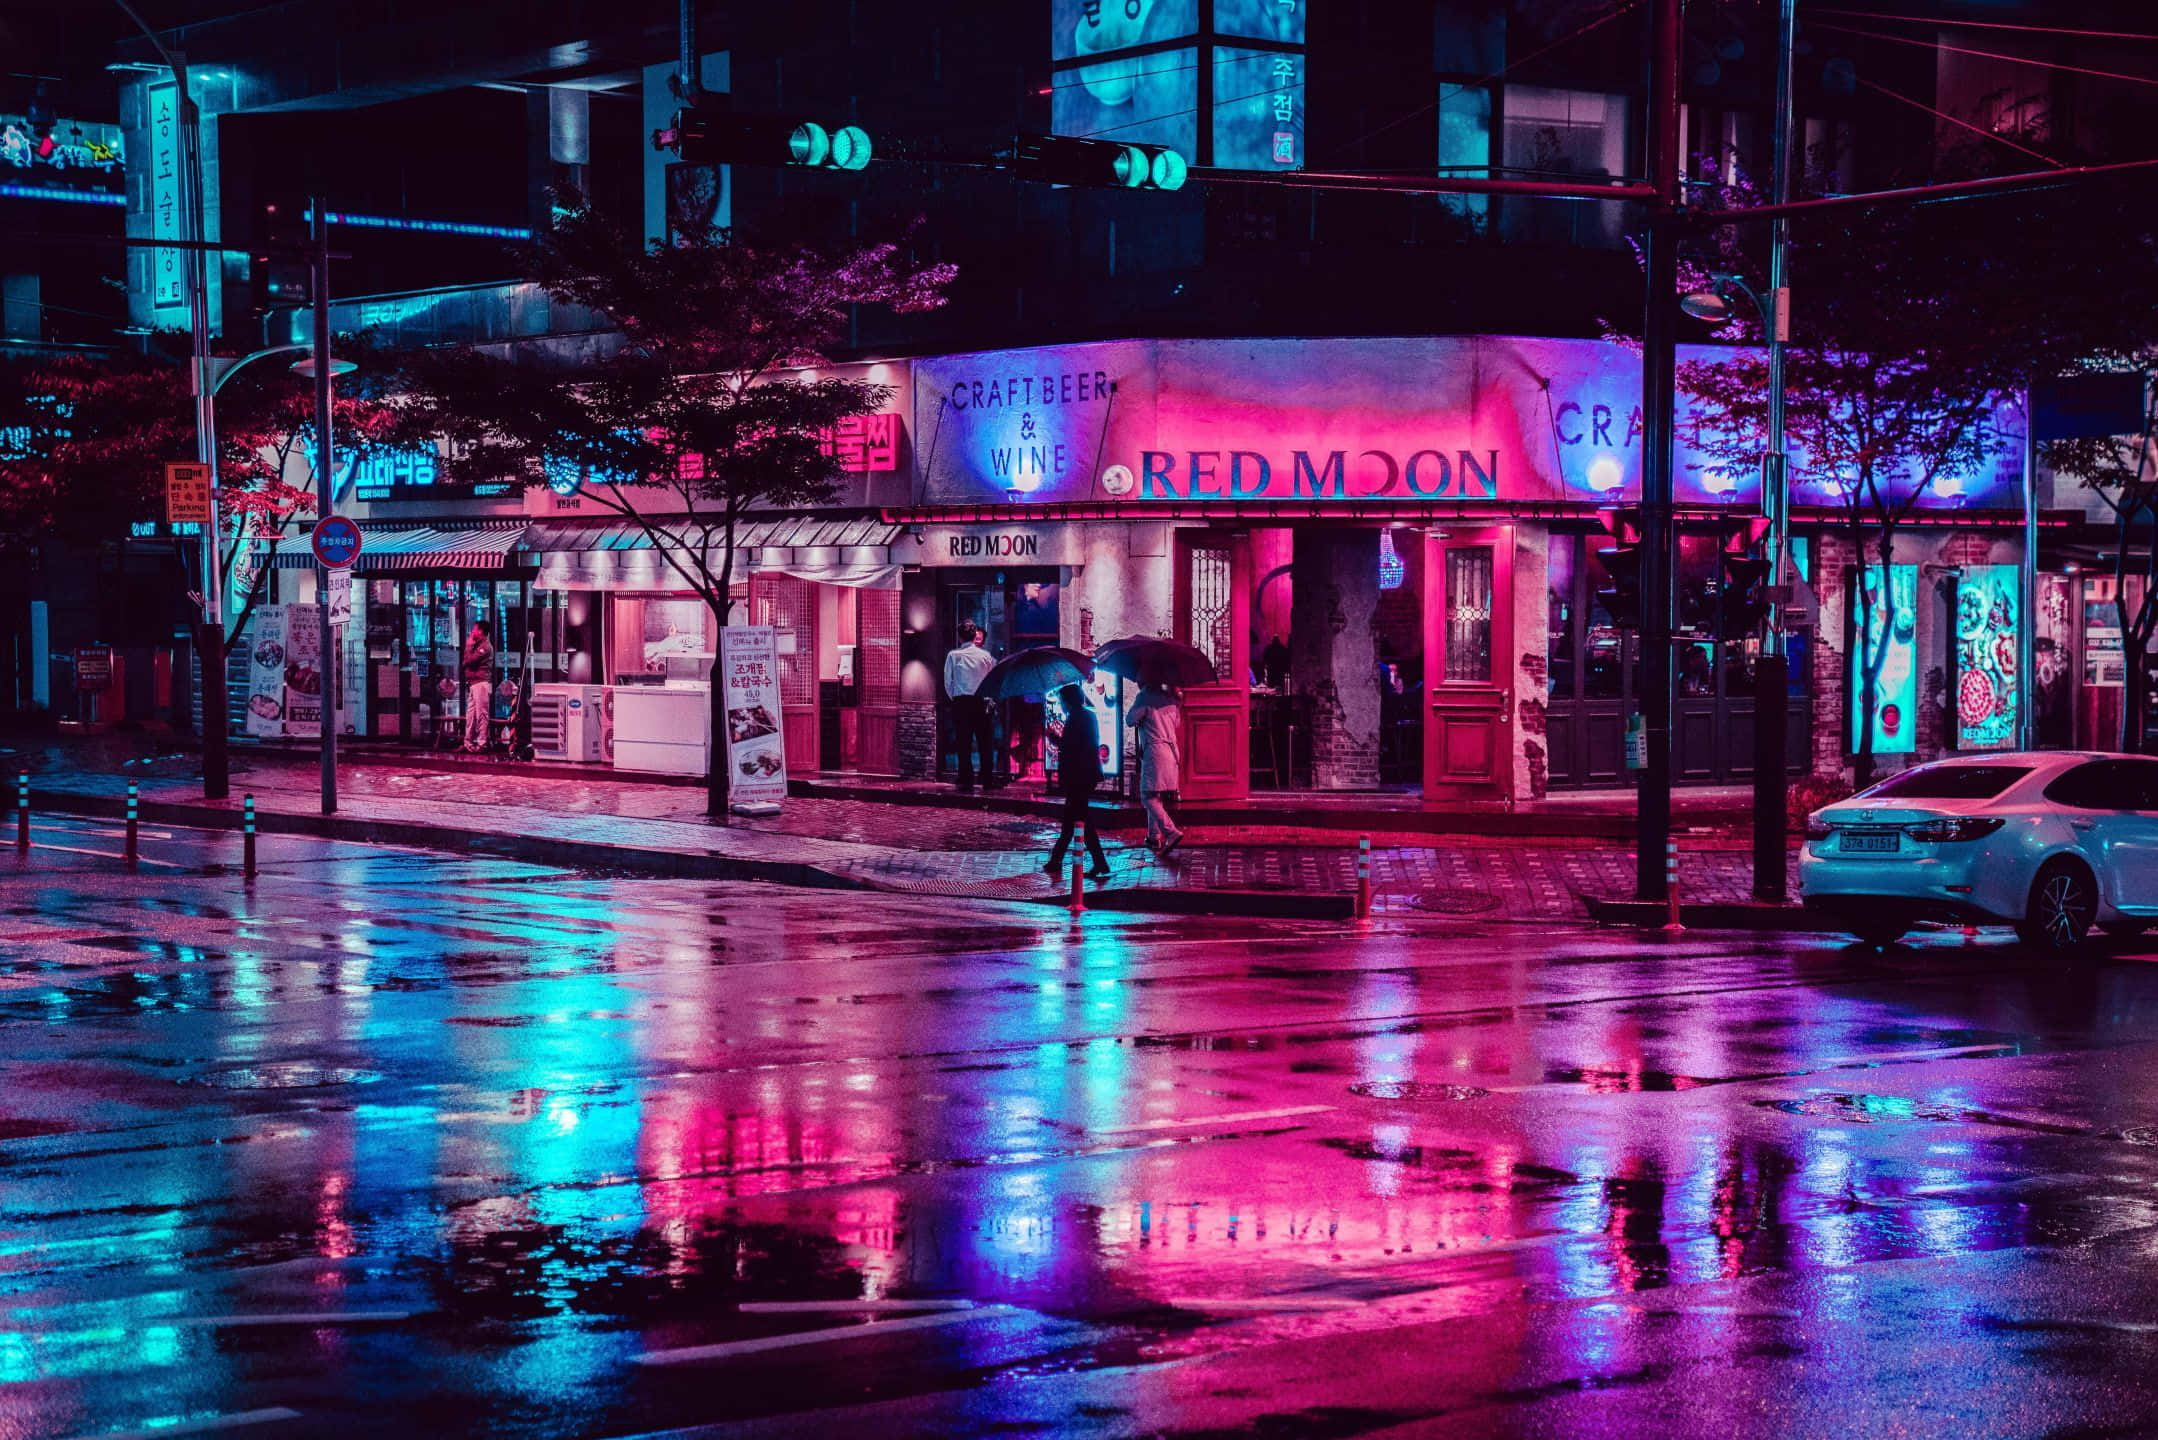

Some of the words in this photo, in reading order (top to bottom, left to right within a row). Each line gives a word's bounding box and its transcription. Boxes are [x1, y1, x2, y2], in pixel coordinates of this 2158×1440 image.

[1272, 58, 1296, 123] 주점
[951, 378, 1034, 410] CRAFT
[1043, 371, 1107, 405] BEER
[1020, 412, 1036, 440] &
[991, 444, 1065, 477] WINE
[1140, 450, 1271, 498] RED
[1290, 450, 1500, 498] MOON
[172, 504, 205, 512] Parking
[949, 535, 982, 556] RED
[985, 534, 1037, 556] MOON
